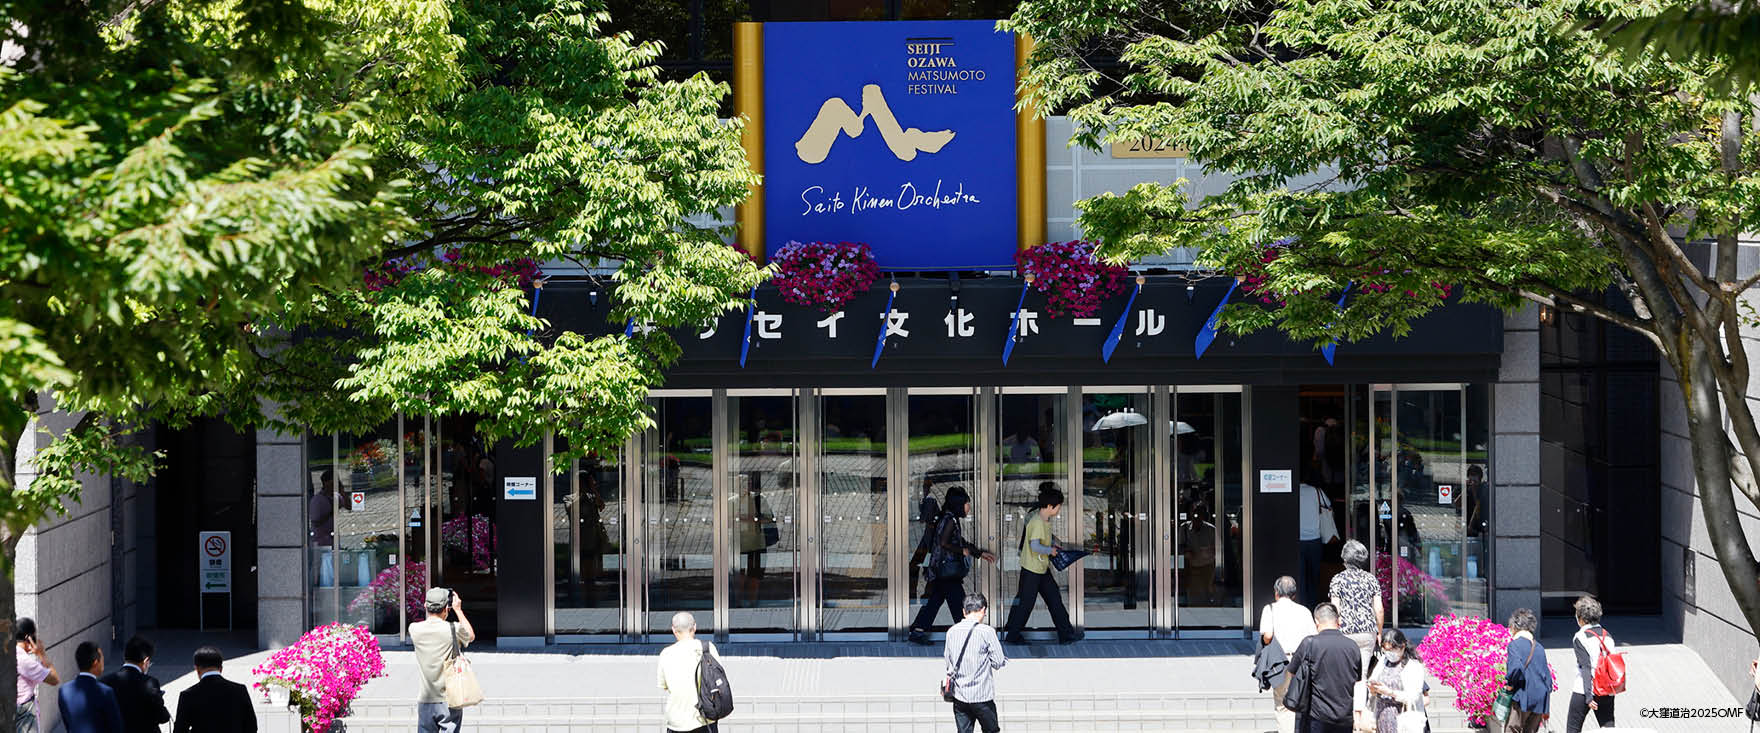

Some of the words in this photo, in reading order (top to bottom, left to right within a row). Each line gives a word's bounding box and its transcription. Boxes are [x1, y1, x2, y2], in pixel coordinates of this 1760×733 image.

[907, 43, 941, 56] SEIJI
[907, 57, 956, 68] OZAWA
[907, 70, 986, 81] MATSUMOTO
[908, 84, 958, 95] FESTIVAL
[1129, 131, 1191, 152] 2024.
[801, 185, 845, 216] Saito
[852, 186, 894, 215] Kinen
[897, 179, 981, 211] Orchestra
